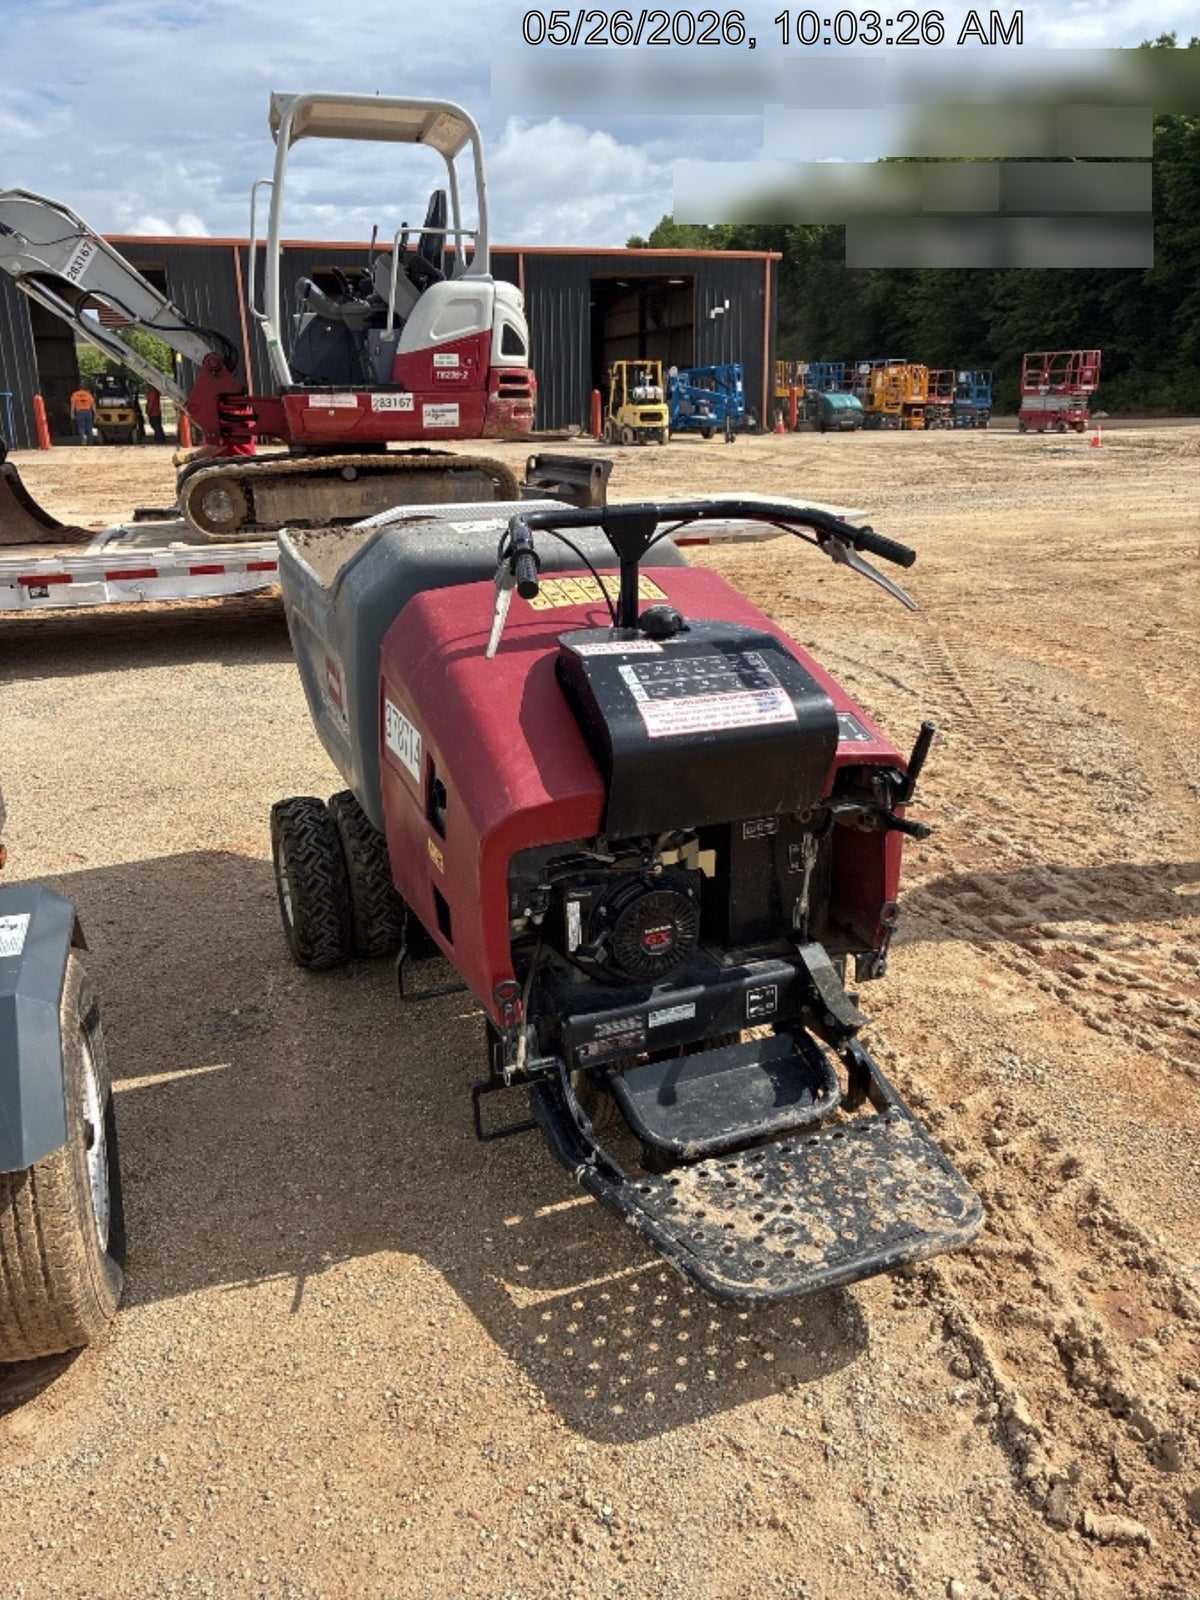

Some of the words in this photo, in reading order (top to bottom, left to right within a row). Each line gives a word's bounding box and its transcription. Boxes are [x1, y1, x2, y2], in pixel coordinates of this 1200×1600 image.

[67, 242, 93, 281] 283167
[374, 397, 412, 410] 283167
[644, 933, 671, 946] GX
